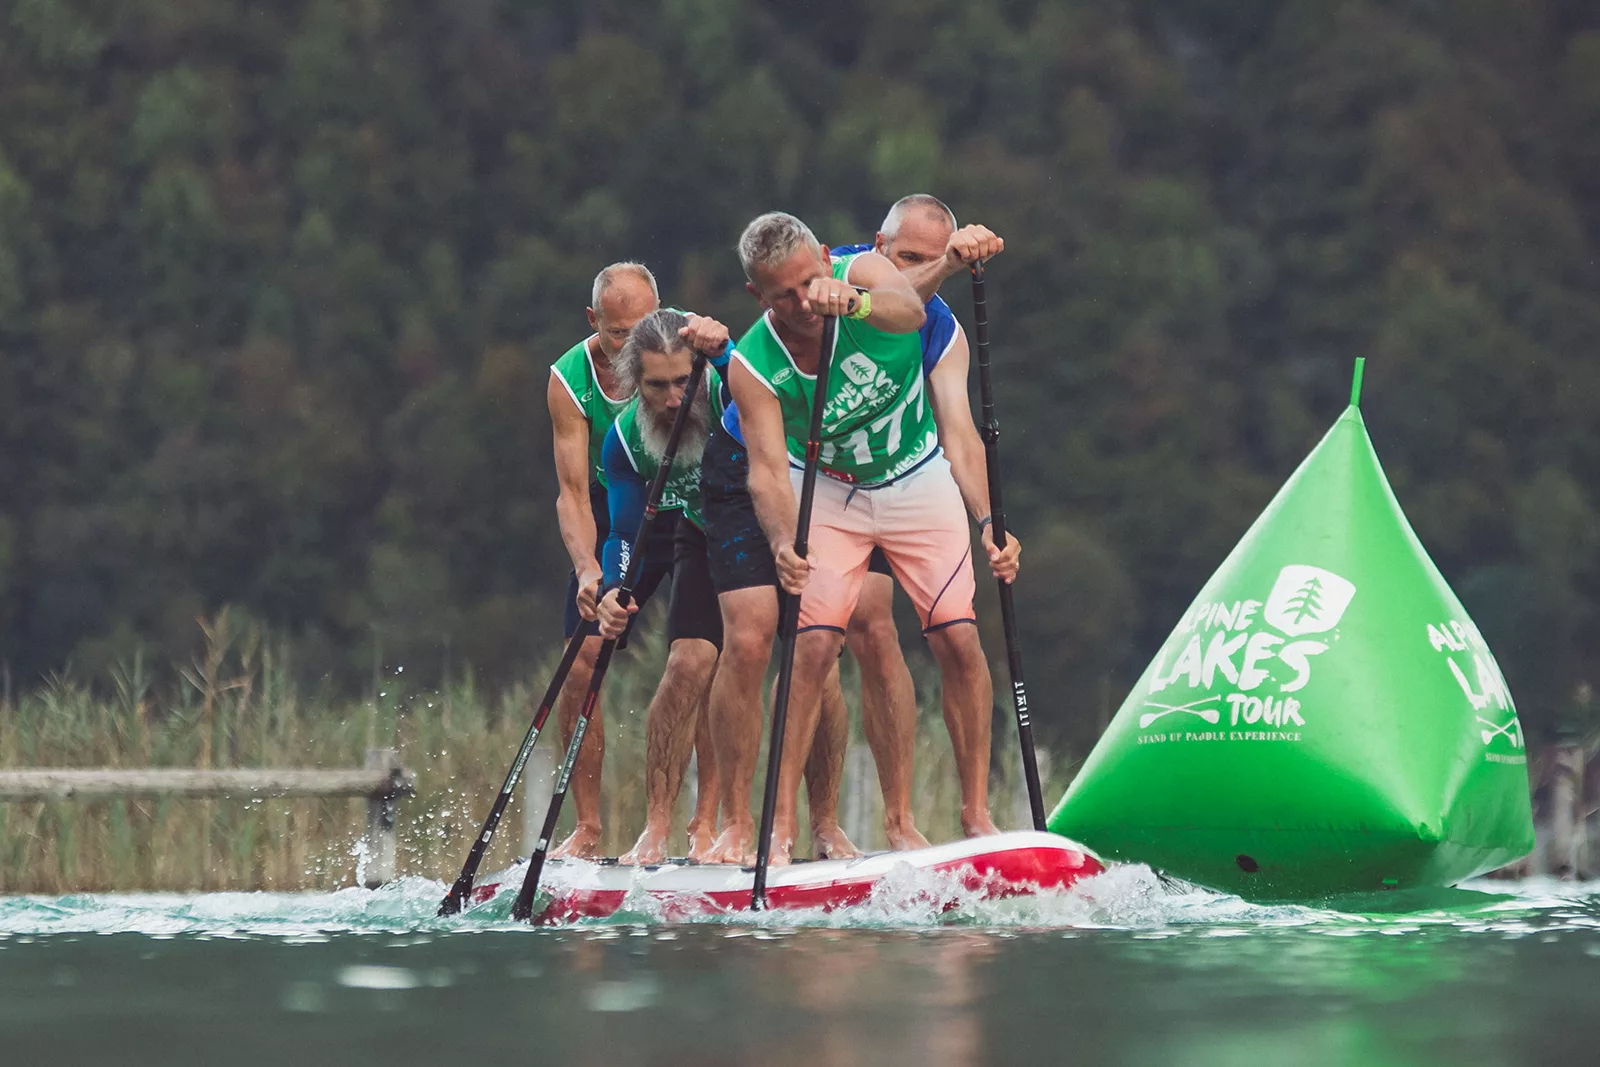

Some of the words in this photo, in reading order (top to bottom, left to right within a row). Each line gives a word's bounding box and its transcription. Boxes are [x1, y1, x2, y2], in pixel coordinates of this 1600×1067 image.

[1147, 631, 1330, 696] LAKES
[1014, 682, 1030, 726] ITIWIT
[1226, 692, 1306, 728] TOUR
[1137, 733, 1167, 745] STAND
[1170, 733, 1181, 743] UP
[1185, 731, 1226, 742] PADDLE
[1229, 731, 1302, 742] EXPERIENCE
